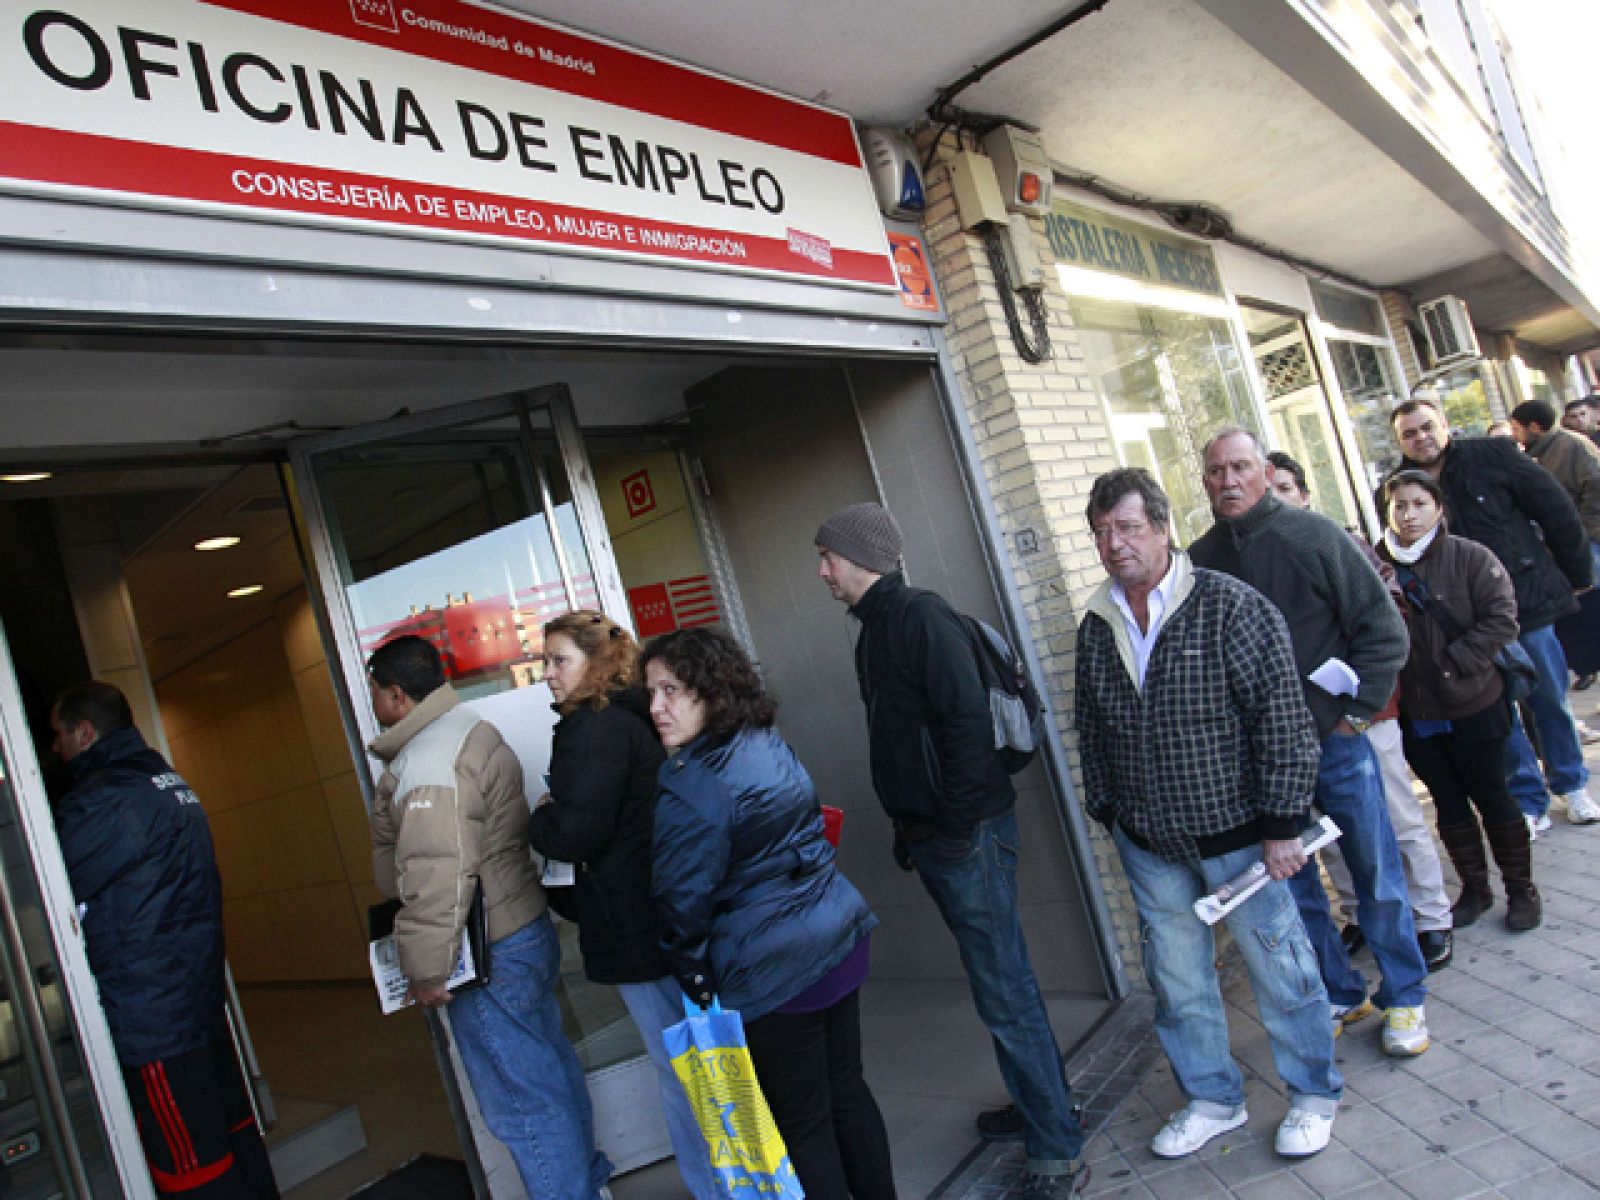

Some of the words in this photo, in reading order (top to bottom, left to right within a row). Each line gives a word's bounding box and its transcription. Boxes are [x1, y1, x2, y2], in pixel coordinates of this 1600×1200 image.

[401, 8, 509, 51] Comunidad
[513, 40, 536, 58] de
[538, 47, 597, 76] Madrid
[22, 9, 445, 153] OFICINA
[457, 100, 557, 173] DE
[568, 125, 785, 215] EMPLEO
[231, 169, 411, 214] CONSEJERÍA
[414, 194, 451, 219] DE
[454, 199, 552, 235] EMPLEO,
[553, 214, 622, 242] MUJER
[624, 225, 638, 244] E
[640, 229, 747, 259] INMIGRACIÓN
